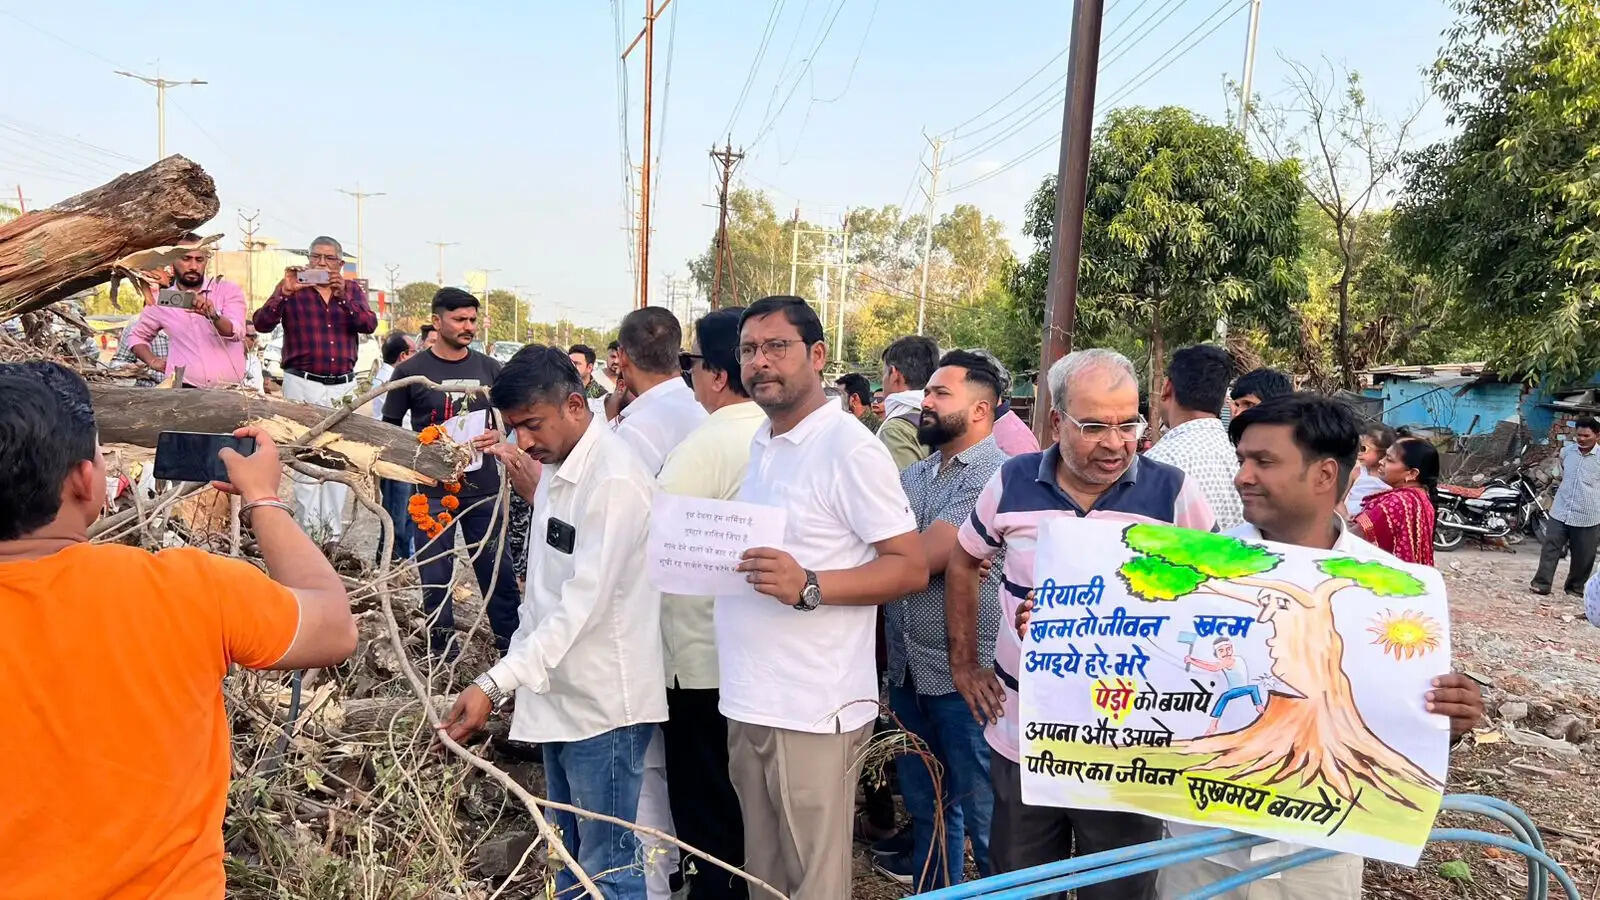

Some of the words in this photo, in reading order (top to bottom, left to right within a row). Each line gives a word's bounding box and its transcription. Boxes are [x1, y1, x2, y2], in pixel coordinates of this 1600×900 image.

[1099, 606, 1170, 638] जीवन
[1193, 614, 1255, 638] खत्म
[1025, 643, 1083, 678] आइये
[1134, 682, 1158, 710] को
[1158, 679, 1216, 714] बचायें
[1025, 720, 1080, 742] अपना
[1082, 718, 1118, 748] और
[1122, 717, 1174, 748] अपने
[1025, 750, 1086, 784] परिवार
[1086, 762, 1113, 782] का
[1115, 758, 1182, 786] जीवन
[1187, 776, 1269, 811] सुखमय
